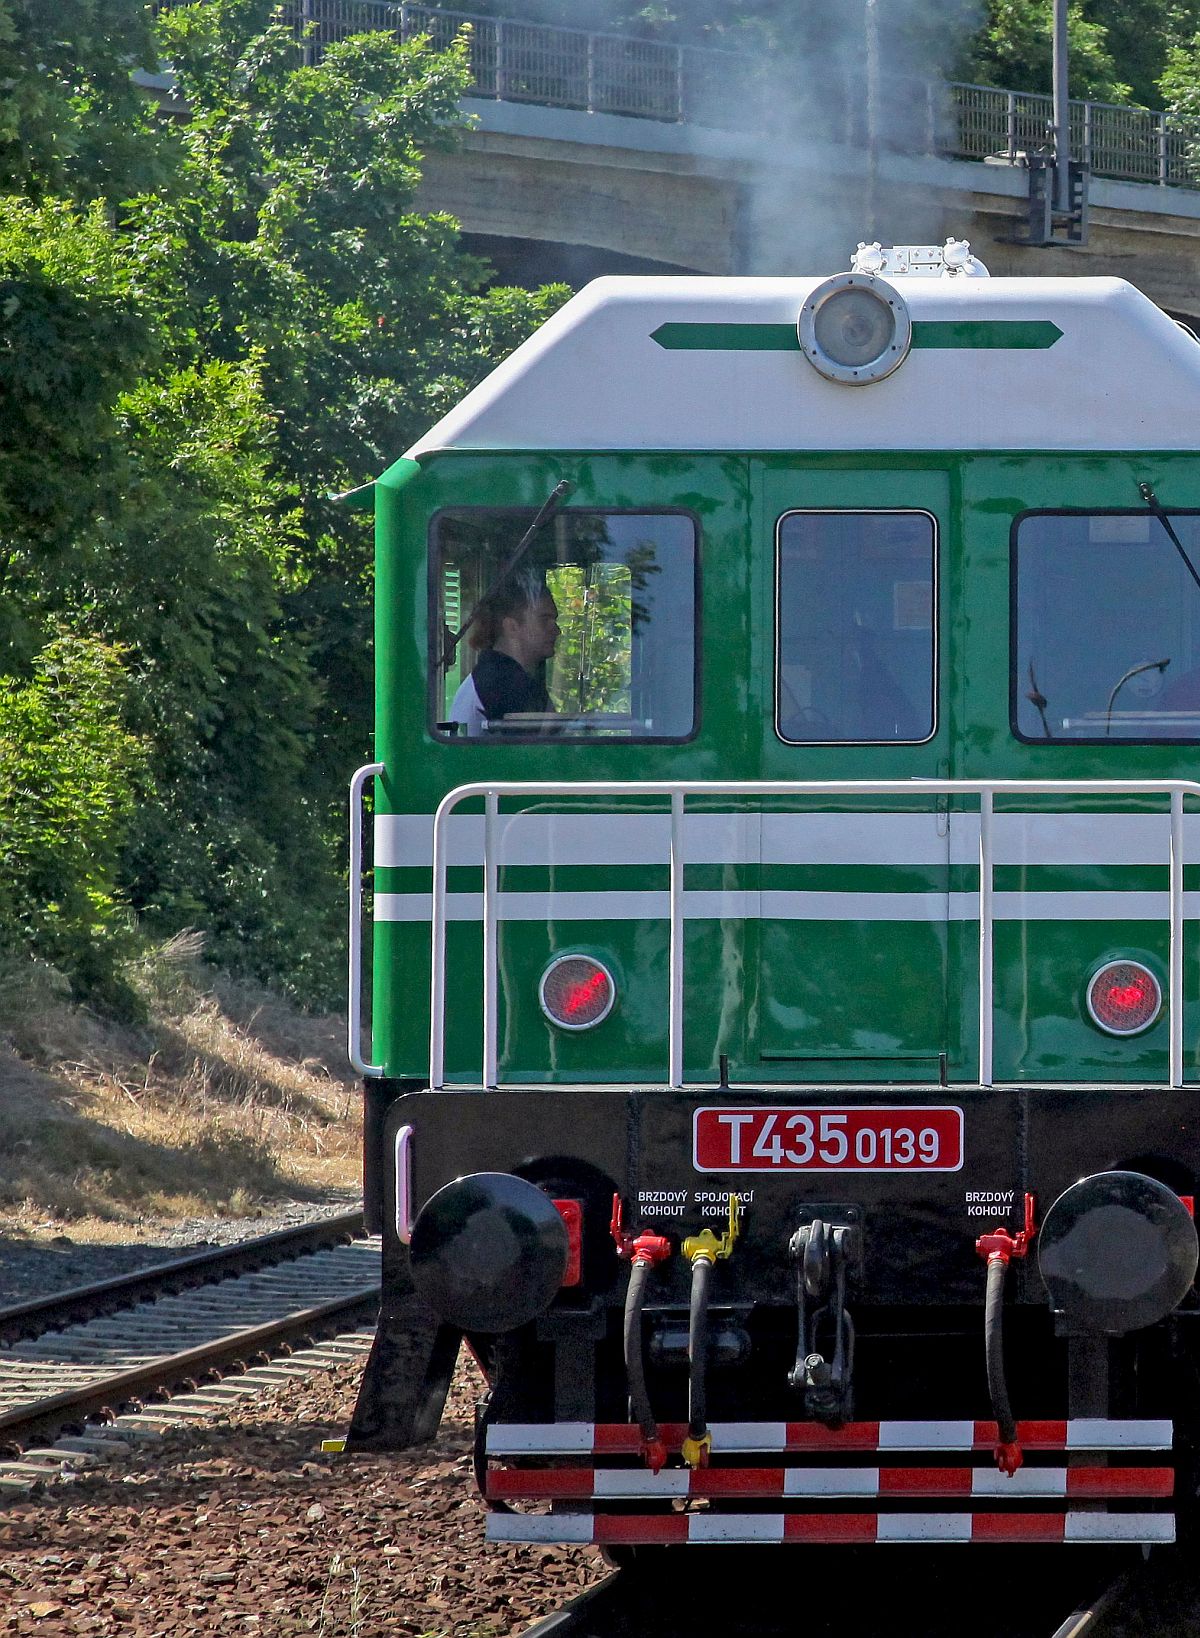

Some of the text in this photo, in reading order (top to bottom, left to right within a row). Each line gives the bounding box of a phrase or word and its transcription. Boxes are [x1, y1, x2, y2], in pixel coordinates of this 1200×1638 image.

[718, 1114, 939, 1164] T435 0139
[638, 1189, 688, 1202] BRZDOVÝ
[694, 1189, 754, 1202] SPOJOACÍ
[965, 1189, 1015, 1202] BRZDOVÝ
[640, 1205, 686, 1216] KOHOUT
[967, 1205, 1012, 1216] KOHOUT
